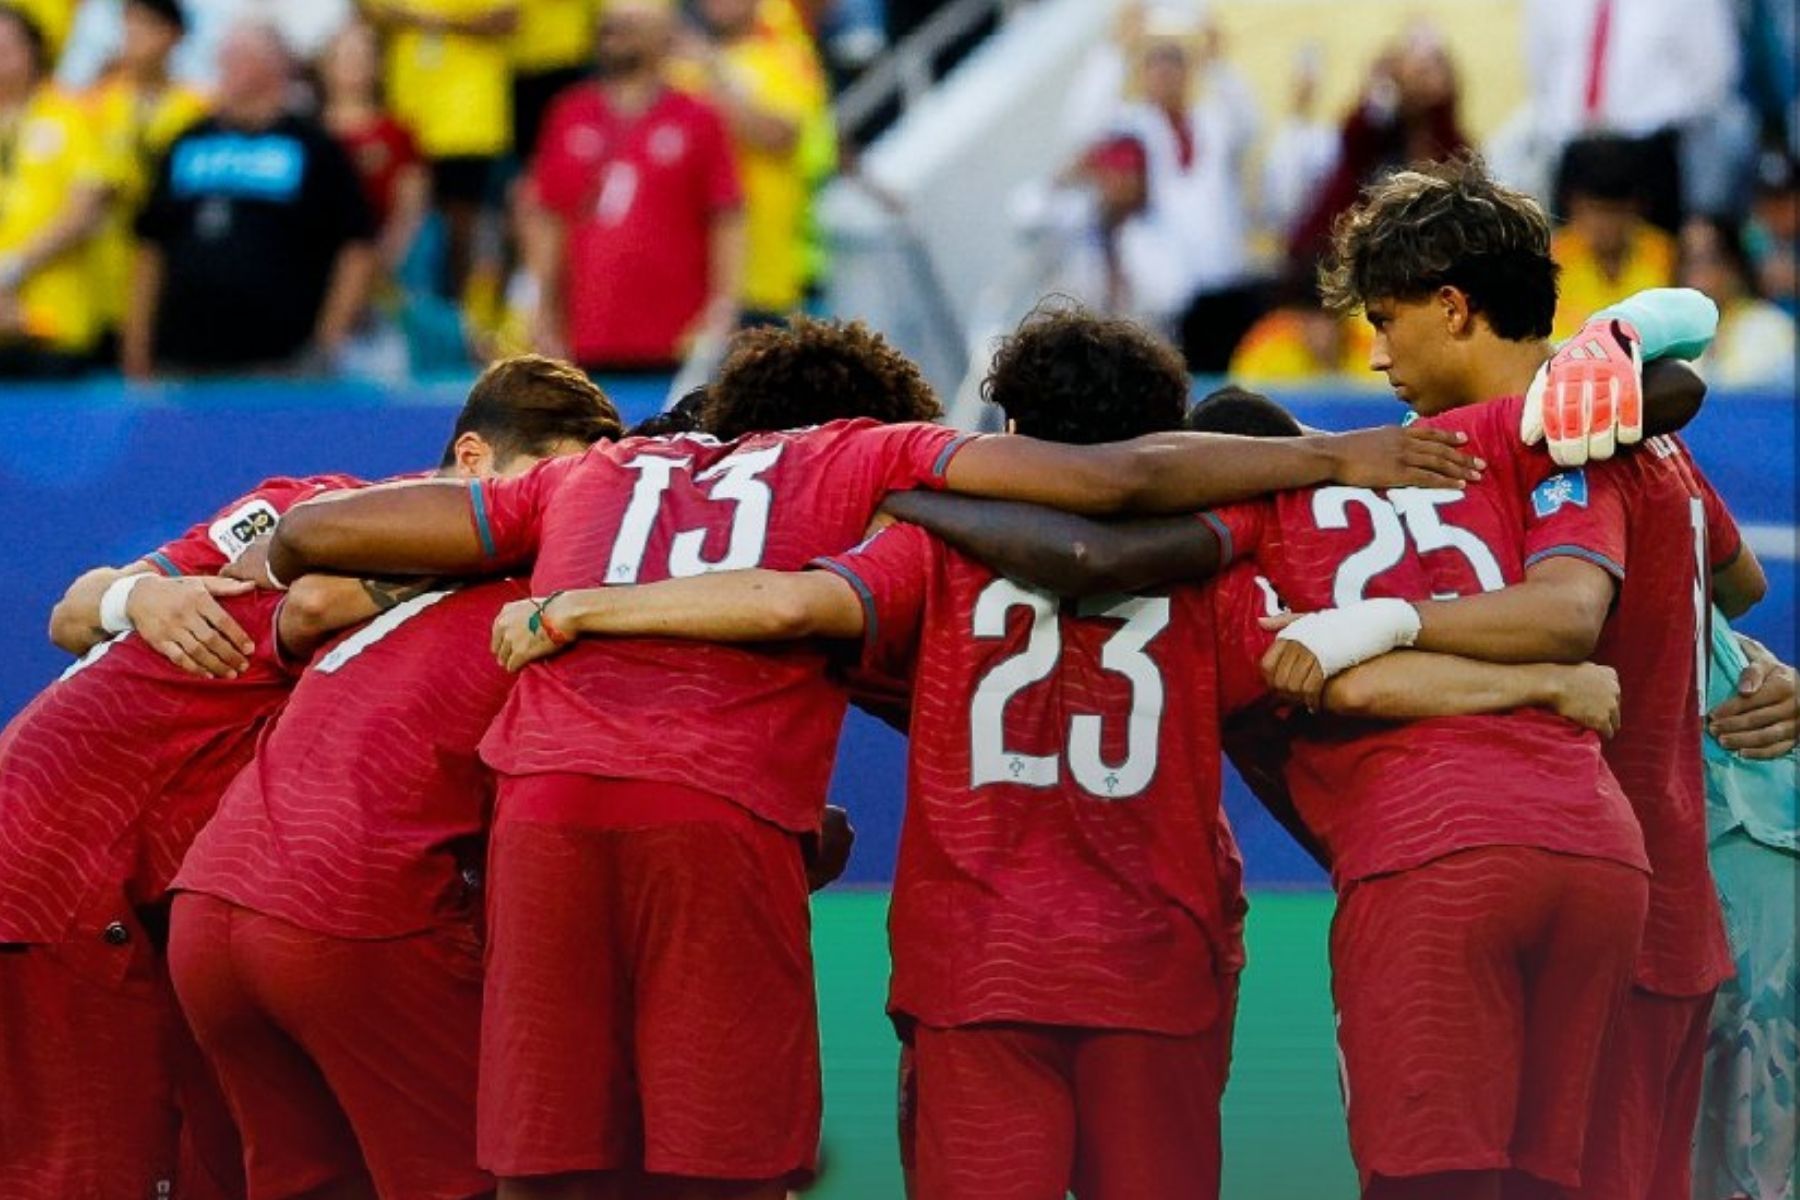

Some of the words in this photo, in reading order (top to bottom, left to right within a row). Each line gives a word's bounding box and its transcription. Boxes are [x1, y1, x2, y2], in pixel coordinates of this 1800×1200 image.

[603, 443, 784, 584] 13
[1312, 486, 1505, 609] 25
[971, 577, 1170, 798] 23
